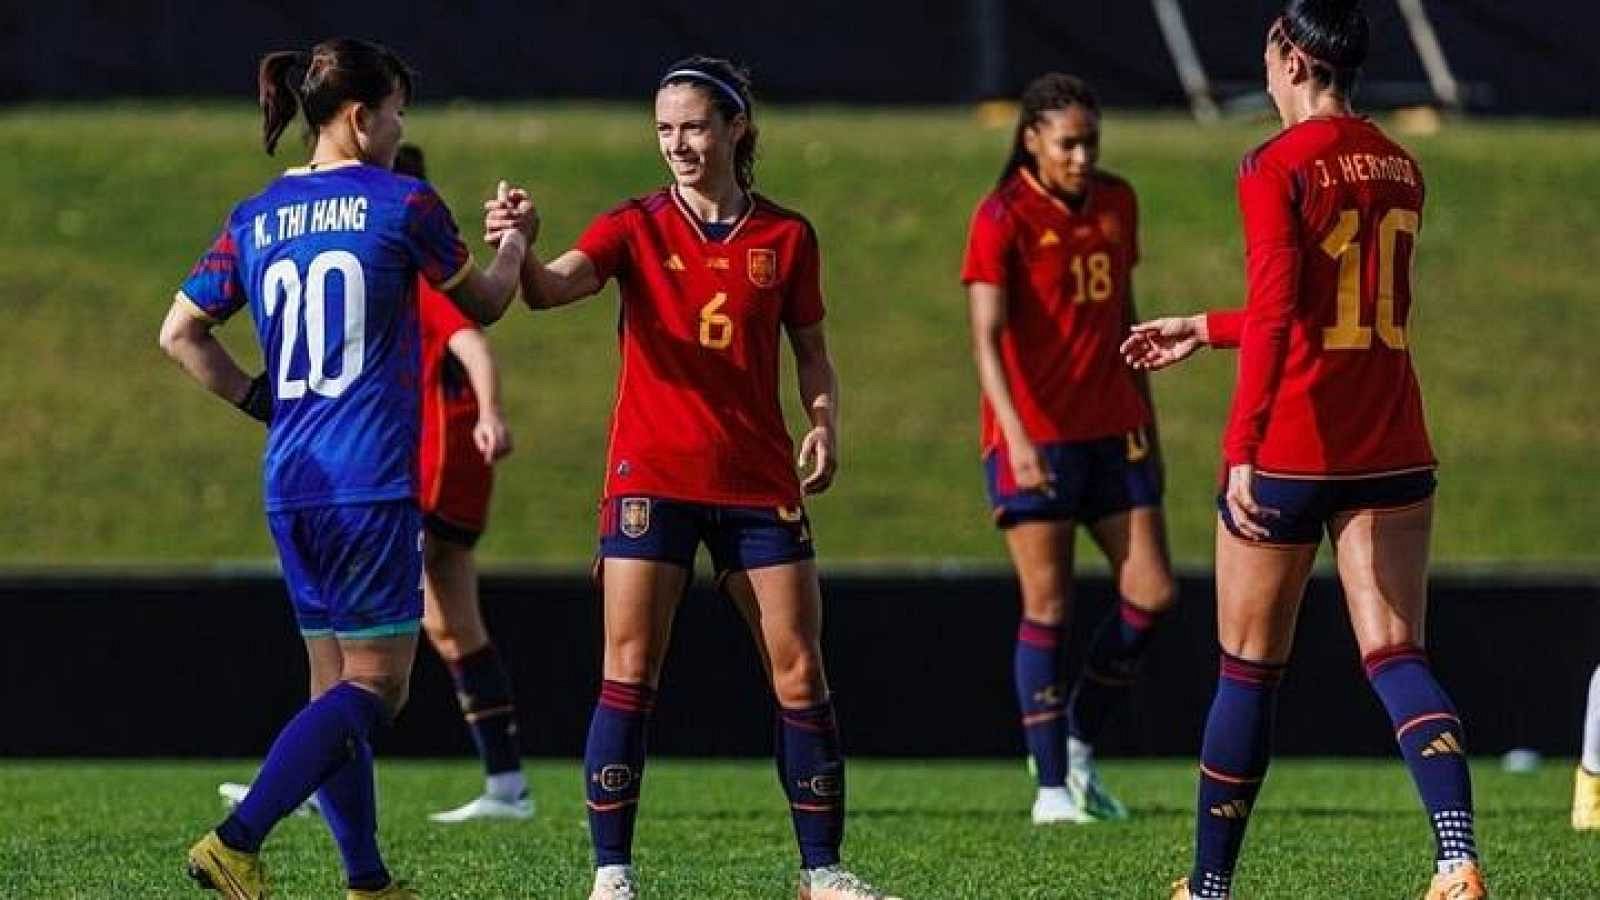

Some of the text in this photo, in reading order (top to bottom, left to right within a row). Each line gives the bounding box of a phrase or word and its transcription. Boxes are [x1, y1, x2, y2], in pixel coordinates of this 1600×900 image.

[1315, 160, 1337, 187] J.
[255, 197, 367, 249] K. THI HANG
[1071, 252, 1112, 303] 18
[1321, 209, 1417, 350] 10
[264, 250, 366, 400] 20
[700, 292, 731, 349] 6
